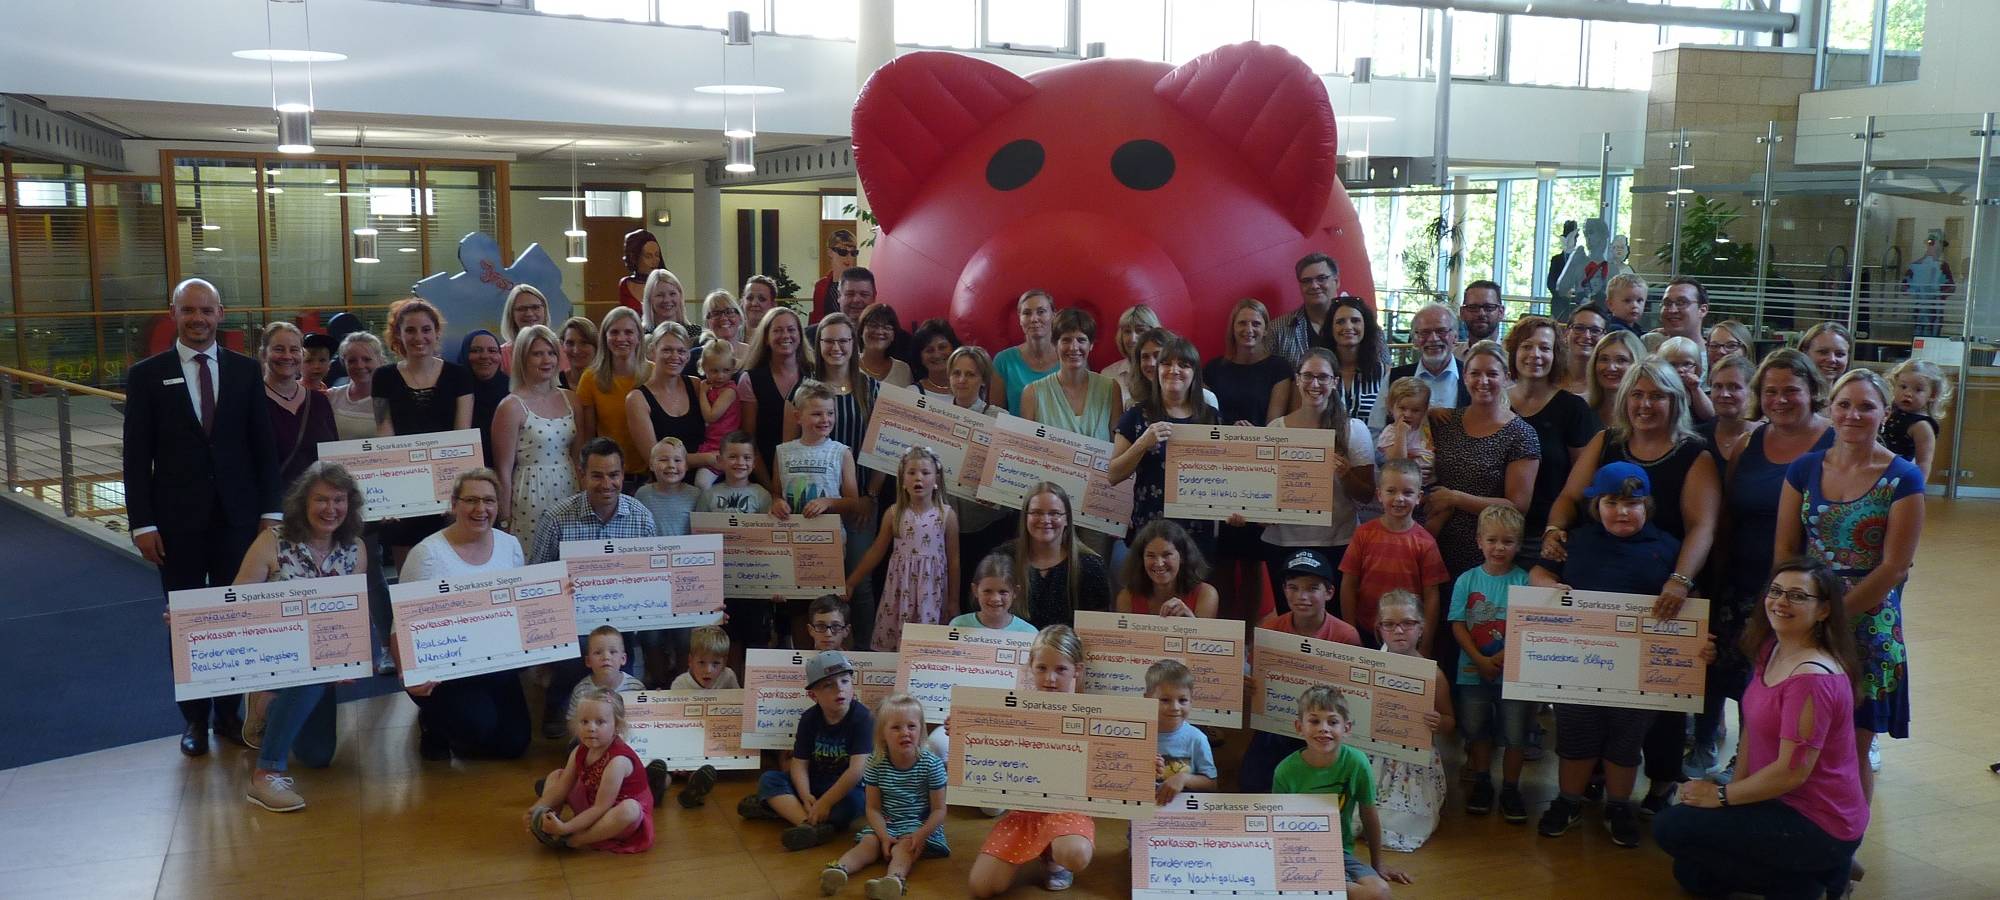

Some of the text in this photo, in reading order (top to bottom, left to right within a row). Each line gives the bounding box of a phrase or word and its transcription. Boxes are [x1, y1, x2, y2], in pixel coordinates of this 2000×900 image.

[929, 405, 961, 420] Sparkasse
[963, 415, 985, 427] Siegen
[375, 439, 439, 451] Sparkasse Siegen
[1048, 433, 1106, 455] Sparkasse Siegen
[1223, 433, 1289, 444] Sparkasse Siegen
[740, 520, 800, 529] Sparkasse Siegen
[617, 543, 681, 555] Sparkasse Siegen
[453, 576, 523, 592] Sparkasse Siegen
[241, 587, 318, 602] Sparkasse Siegen
[284, 604, 300, 613] EUR
[1577, 599, 1653, 614] Sparkasse Siegen
[1131, 623, 1198, 635] Sparkasse Siegen
[1619, 620, 1634, 628] EUR
[187, 624, 304, 645] Sparkassen-Herzenswunsch
[963, 634, 1032, 648] Sparkasse Siegen
[415, 635, 468, 650] Realschule
[999, 652, 1013, 660] EUR
[1315, 647, 1386, 668] Sparkasse Siegen
[192, 659, 240, 672] Realschule
[244, 658, 256, 666] am
[1352, 671, 1367, 679] EUR
[651, 695, 718, 704] Sparkasse Siegen
[1022, 699, 1103, 716] Sparkasse Siegen
[1065, 722, 1081, 730] EUR
[964, 734, 1083, 754] Sparkassen-Herzenswunsch
[964, 754, 1029, 769] Förderverein
[1095, 749, 1129, 761] Siegen
[965, 771, 987, 785] Kiga
[1006, 771, 1041, 785] Marien
[1203, 802, 1284, 813] Sparkasse Siegen
[1248, 820, 1265, 828] EUR
[1149, 837, 1273, 850] Sparkassen-Herzenswunsch
[1150, 856, 1212, 869] Förderverein
[1164, 873, 1182, 887] Kiga
